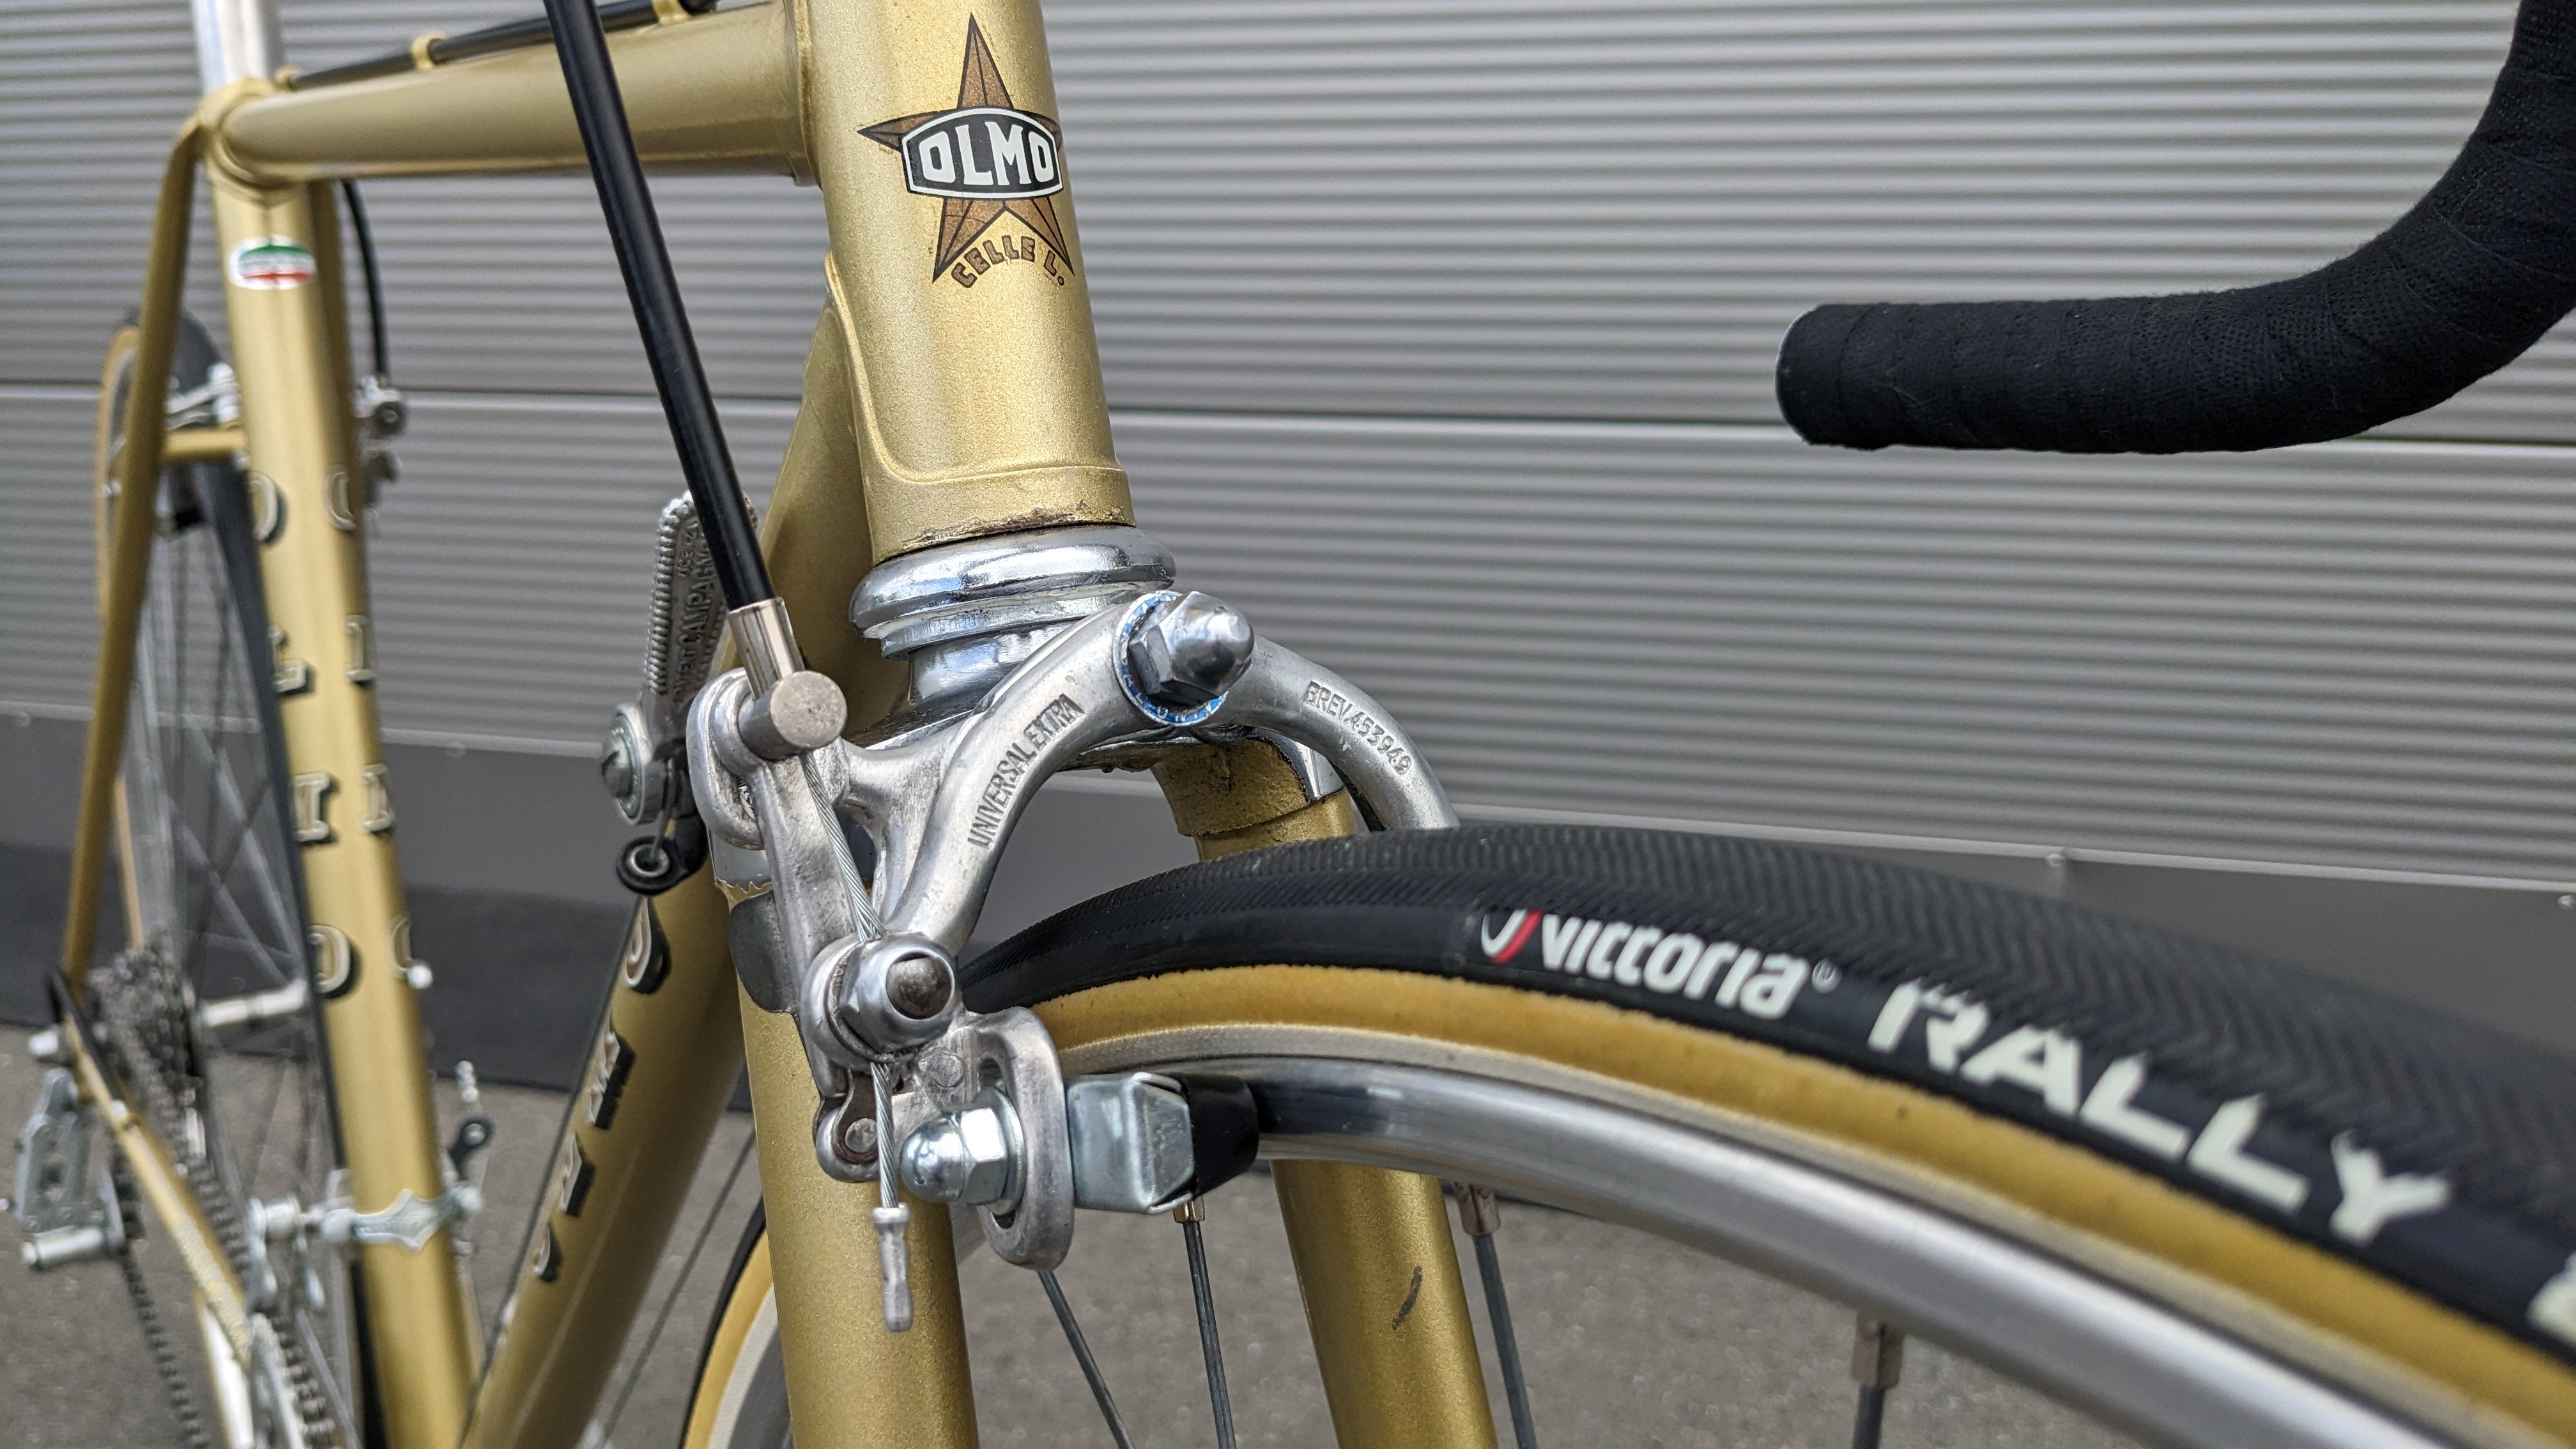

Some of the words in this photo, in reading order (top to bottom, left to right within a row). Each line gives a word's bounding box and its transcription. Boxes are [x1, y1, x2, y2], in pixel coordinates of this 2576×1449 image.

[919, 121, 1055, 187] OLMO
[951, 234, 1036, 289] CELLE
[967, 742, 1038, 849] UNIVERSAL
[1023, 693, 1086, 751] EXTRA
[1867, 977, 2453, 1246] RALLY
